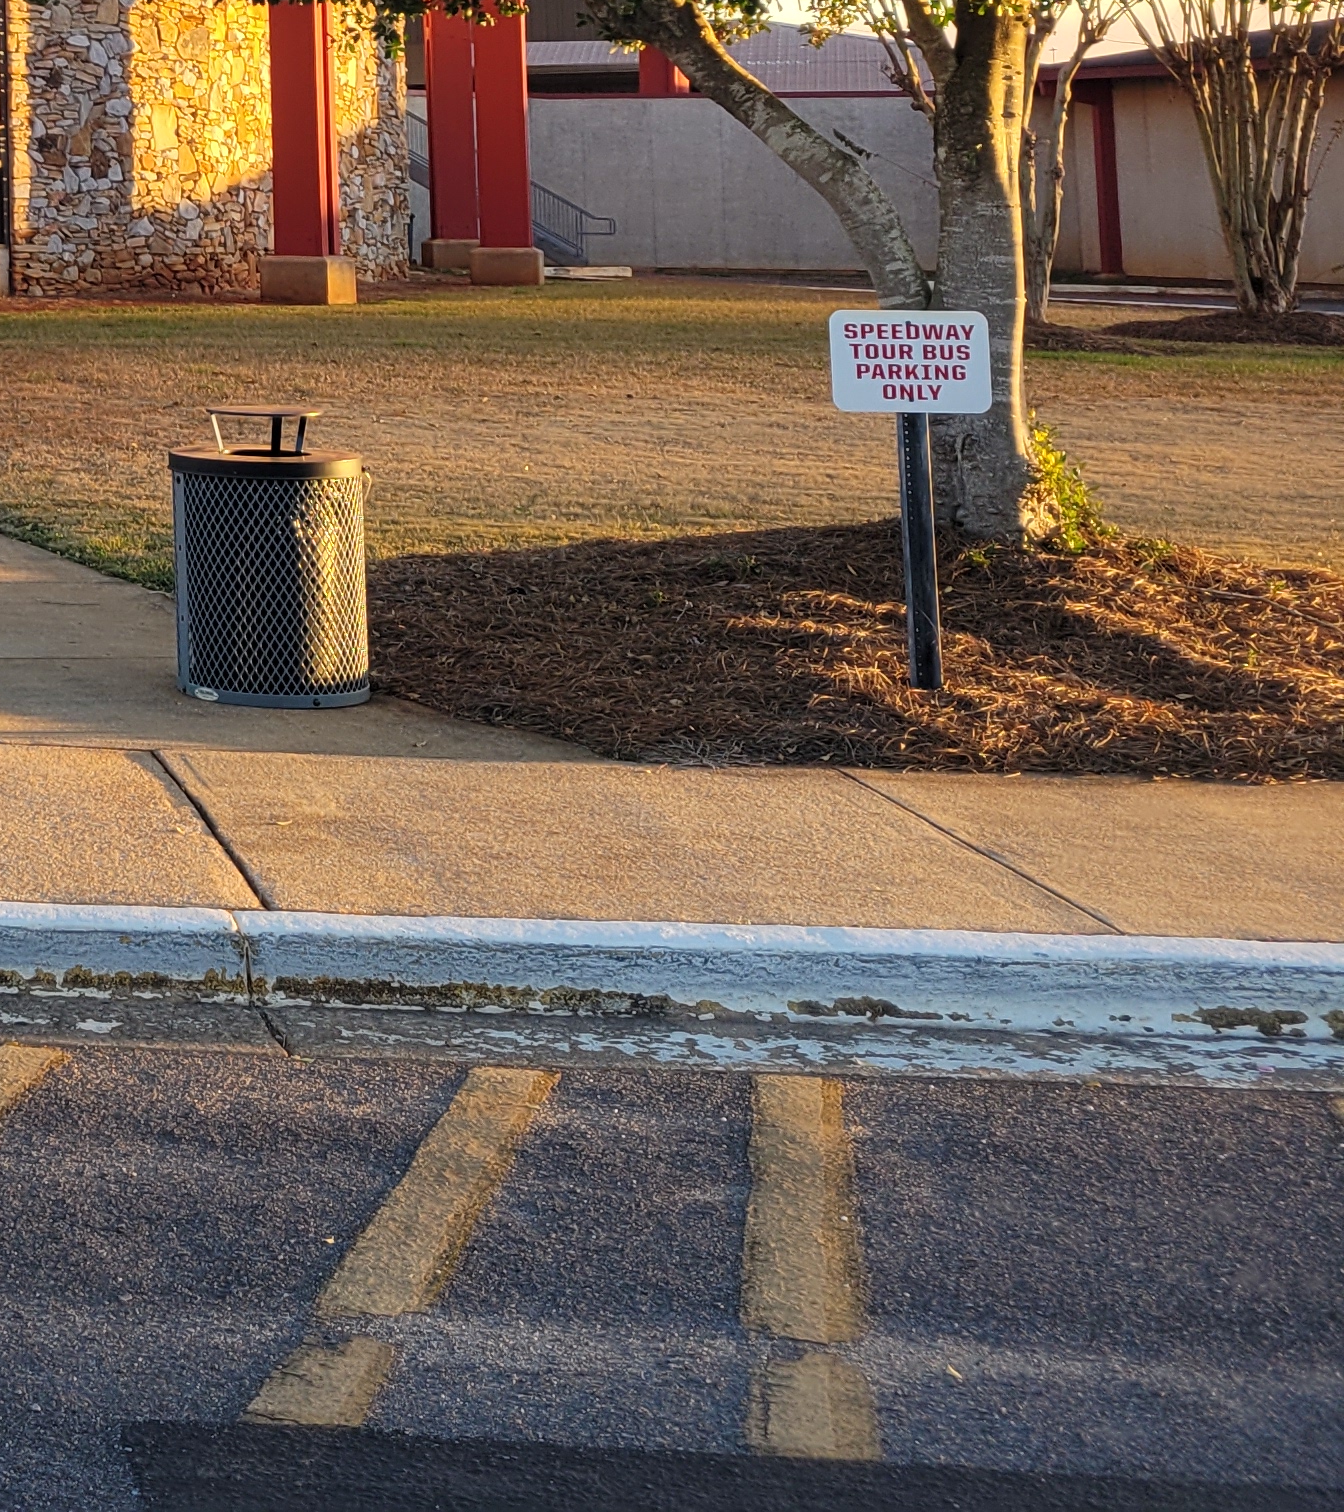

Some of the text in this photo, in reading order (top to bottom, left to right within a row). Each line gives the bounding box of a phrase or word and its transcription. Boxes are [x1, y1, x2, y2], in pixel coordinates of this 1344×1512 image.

[844, 323, 975, 340] SPEEDWAY
[849, 343, 971, 360] TOUR BUS
[856, 363, 967, 381] PARKING
[882, 384, 942, 401] ONLY
